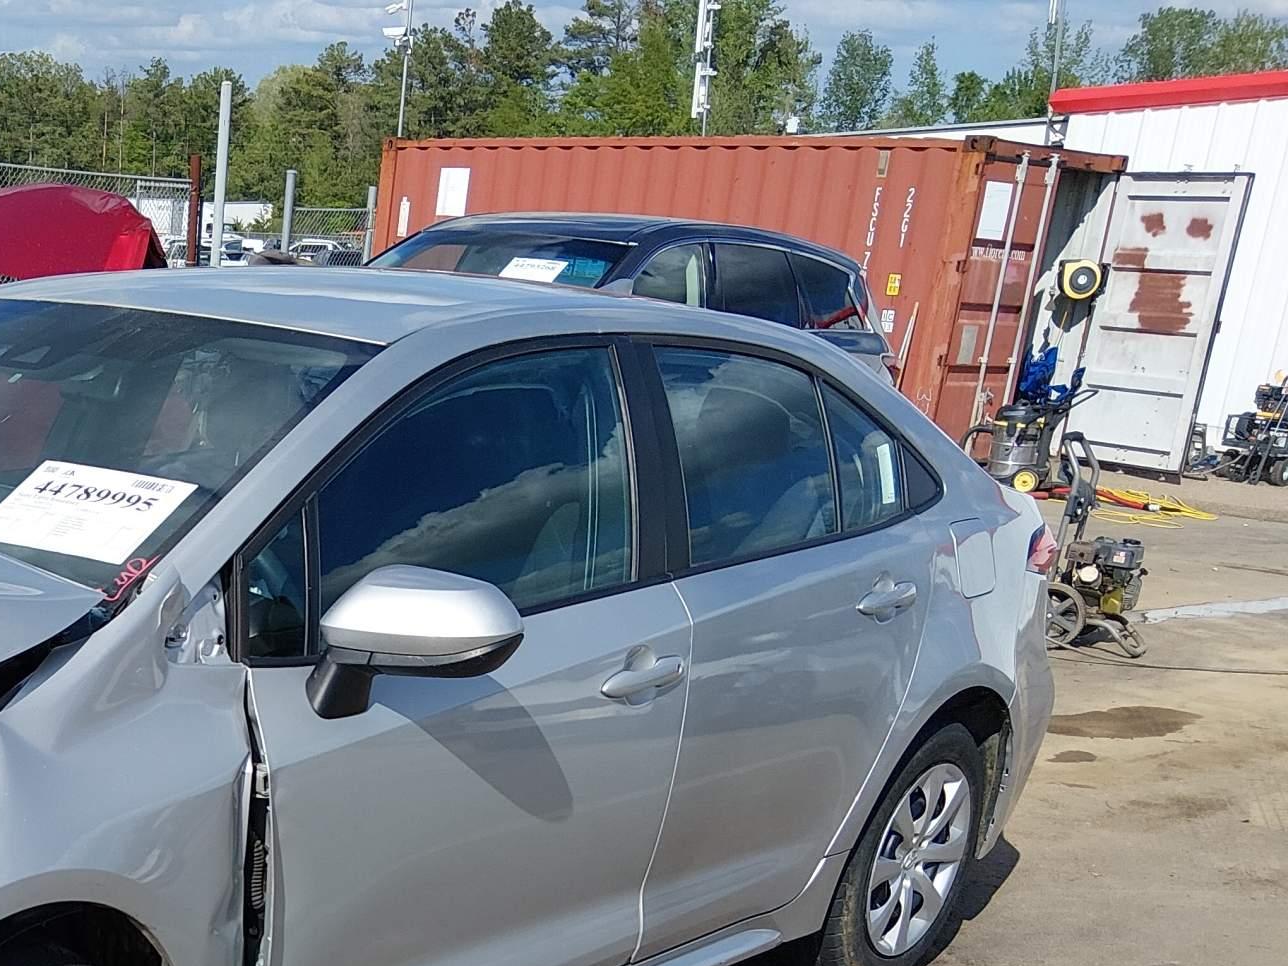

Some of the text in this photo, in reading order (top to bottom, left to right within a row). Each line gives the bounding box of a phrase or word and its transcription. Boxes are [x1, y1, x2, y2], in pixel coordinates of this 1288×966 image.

[866, 187, 882, 246] FSCU
[899, 188, 915, 248] 22G1
[34, 480, 158, 512] 44789995
